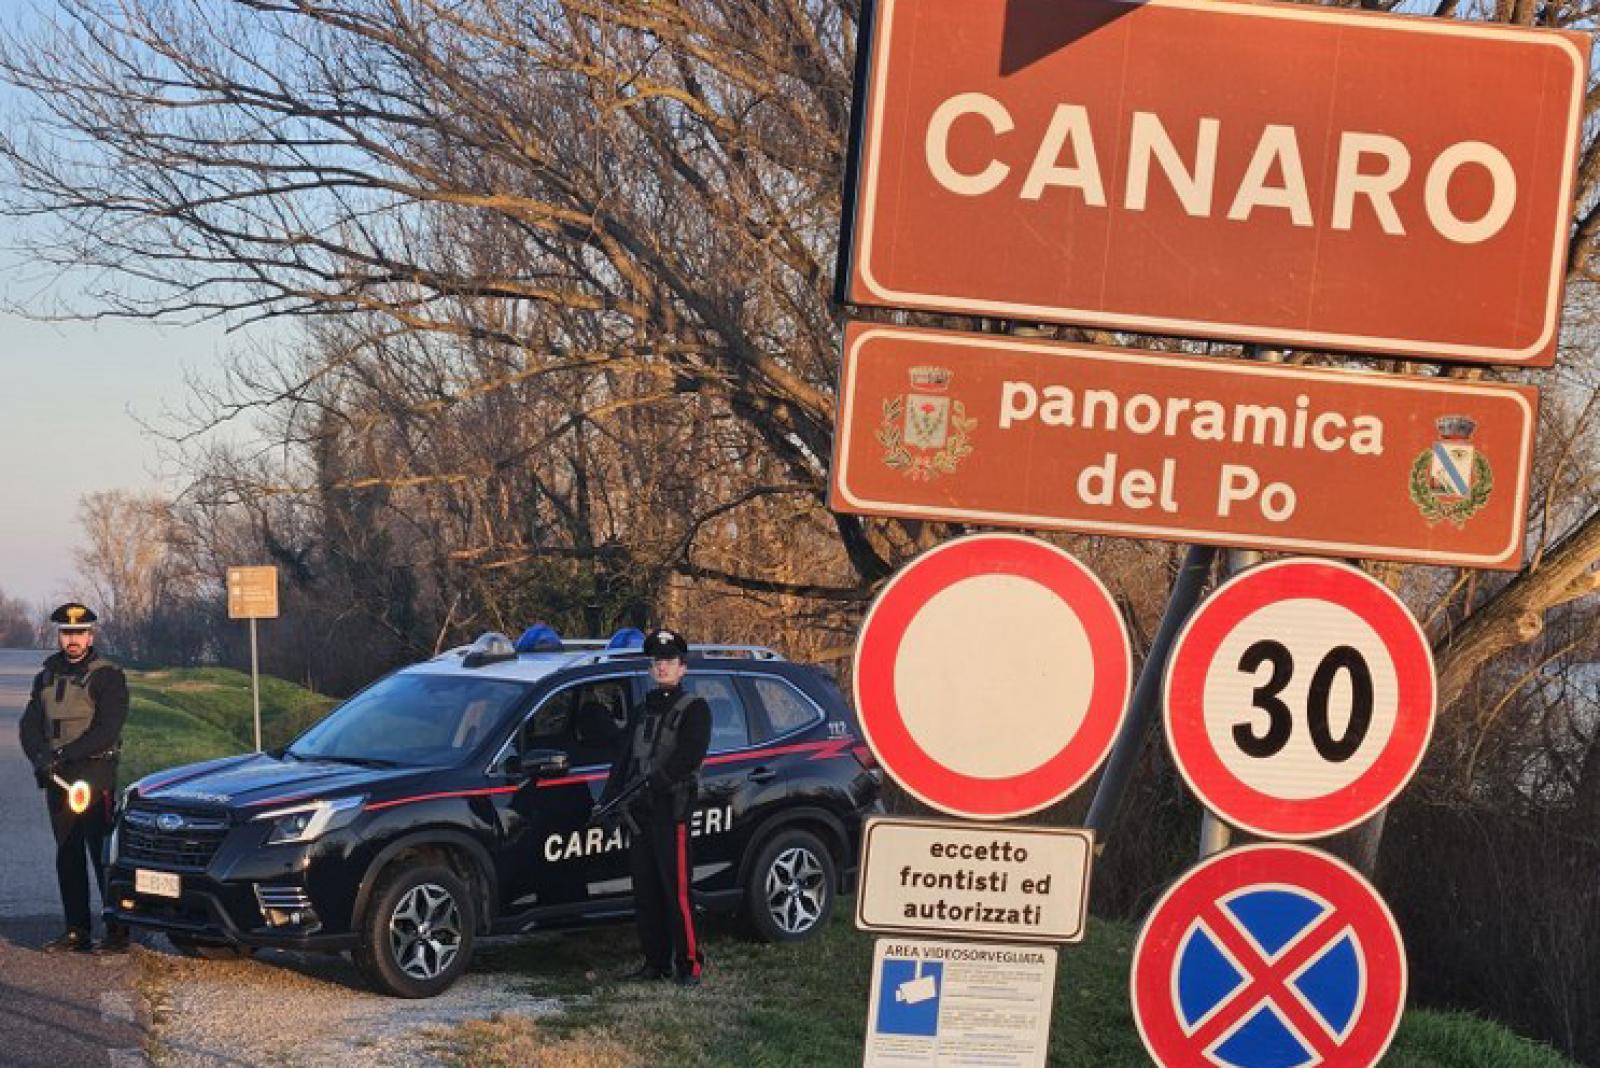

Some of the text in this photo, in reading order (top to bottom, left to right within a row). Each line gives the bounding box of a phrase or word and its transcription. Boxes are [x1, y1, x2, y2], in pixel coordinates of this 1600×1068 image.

[926, 92, 1517, 244] CANARO
[999, 380, 1384, 457] panoramica
[1077, 453, 1297, 523] del Po
[1232, 639, 1374, 763] 30
[544, 804, 733, 862] CARAERI
[930, 840, 1028, 863] eccetto
[900, 866, 1051, 895] frontisti ed
[903, 900, 1041, 926] autorizzati
[885, 944, 920, 957] AREA
